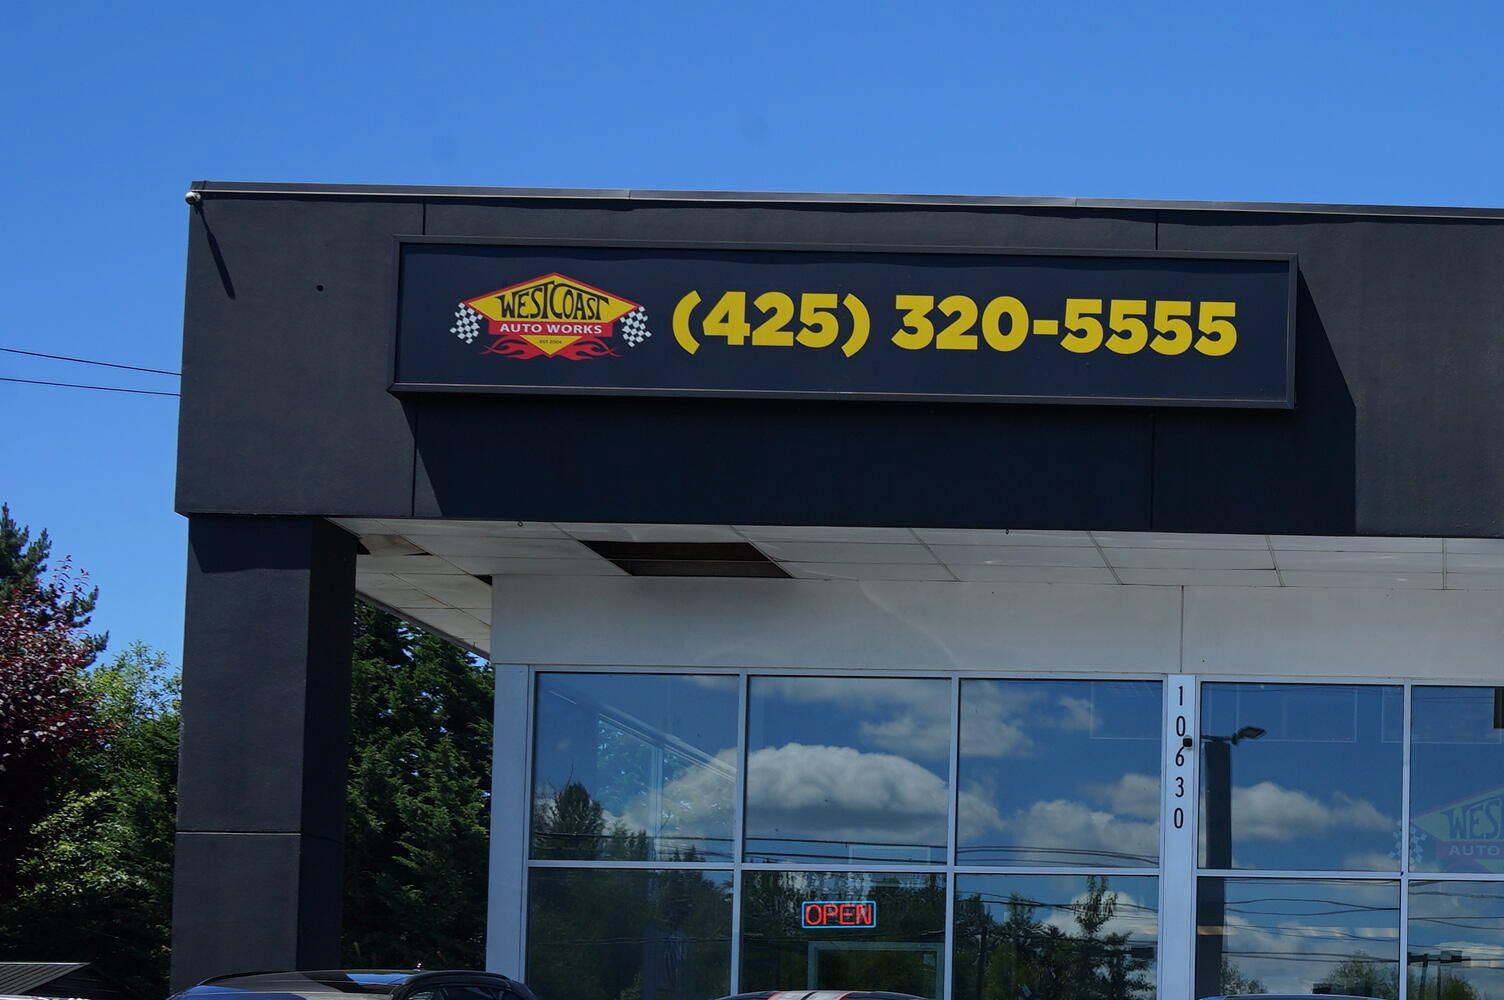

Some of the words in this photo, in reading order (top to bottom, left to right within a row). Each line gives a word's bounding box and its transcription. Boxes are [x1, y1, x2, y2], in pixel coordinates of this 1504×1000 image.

[500, 323, 542, 333] AUTO
[547, 324, 602, 334] WORKS
[672, 290, 871, 358] (425)
[891, 295, 1238, 357] 320-5555
[1449, 845, 1500, 856] AUTO
[805, 904, 872, 925] OPEN
